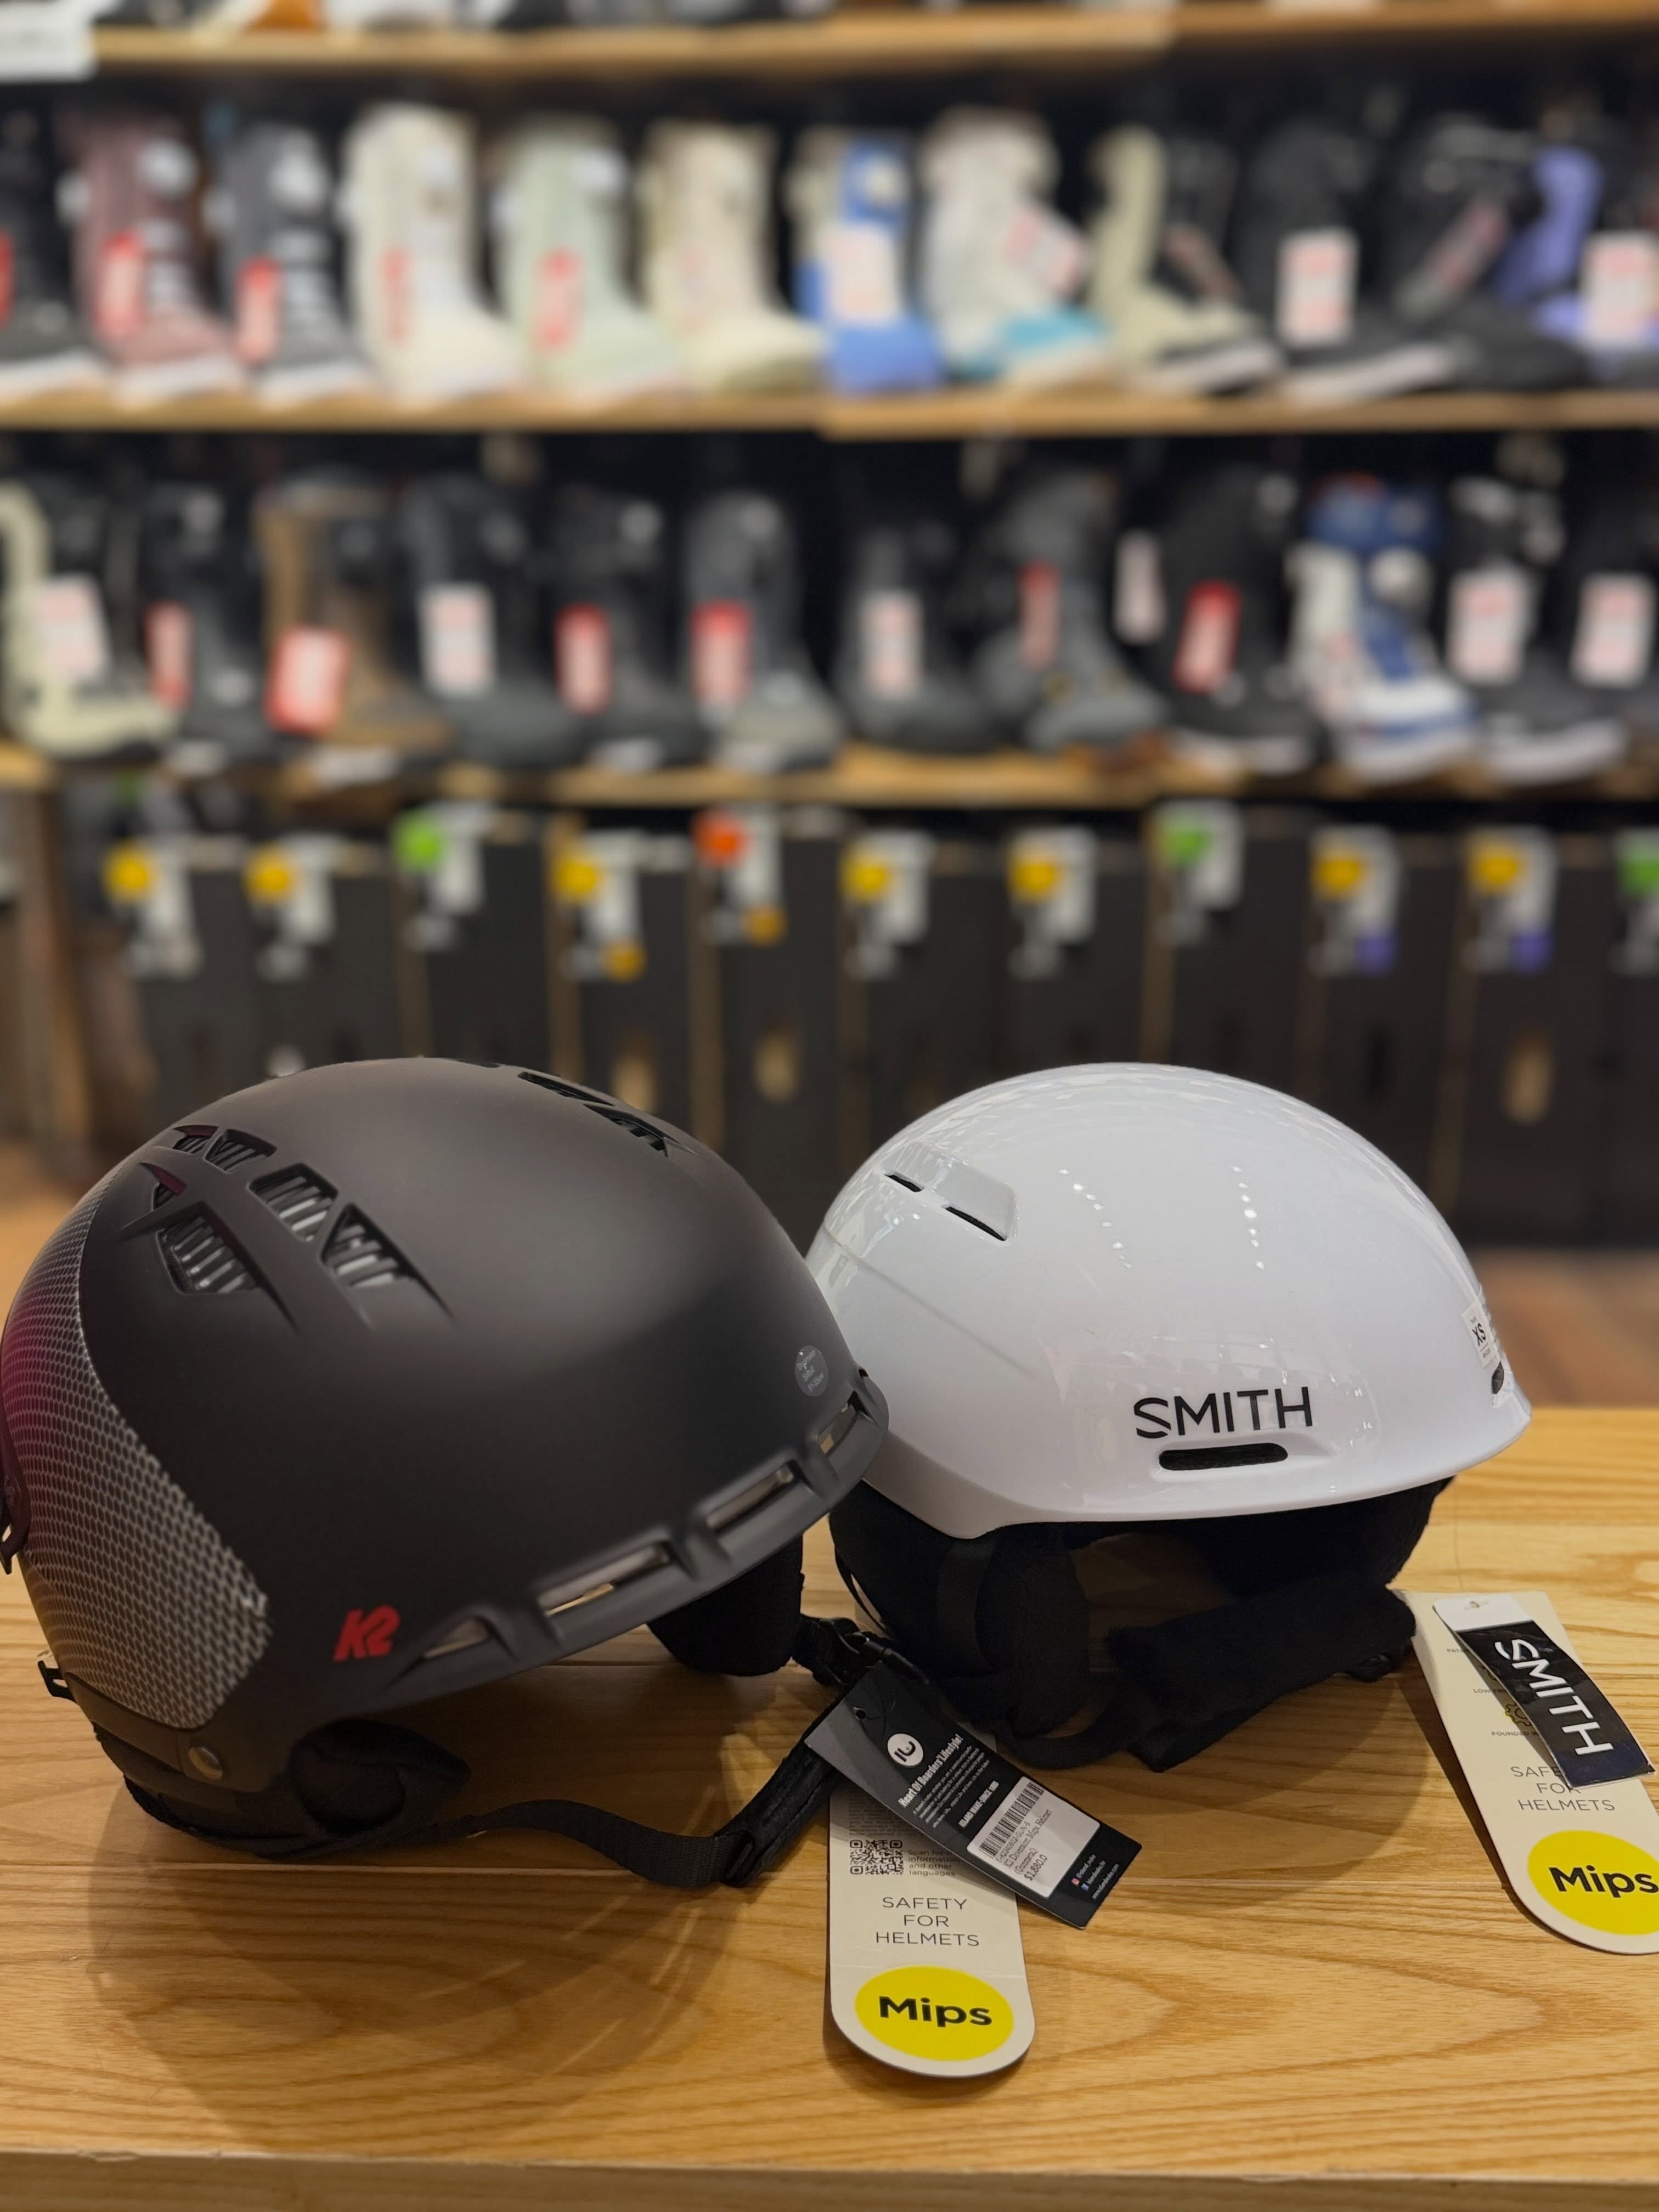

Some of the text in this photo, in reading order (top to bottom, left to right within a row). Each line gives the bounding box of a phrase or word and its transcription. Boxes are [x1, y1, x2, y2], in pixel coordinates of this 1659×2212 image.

[1472, 1323, 1486, 1346] XS
[1133, 1386, 1313, 1438] SMITH
[334, 1605, 400, 1662] K2
[1494, 1639, 1613, 1755] SMITH
[1510, 1766, 1565, 1778] SAFE
[898, 1788, 917, 1807] Heart
[911, 1780, 922, 1791] Of
[1518, 1799, 1615, 1811] HELMETS
[1549, 1865, 1659, 1898] Mips
[882, 1897, 967, 1910] SAFETY
[904, 1915, 949, 1927] FOR
[876, 1932, 979, 1946] HELMETS
[879, 1996, 992, 2028] Mips
